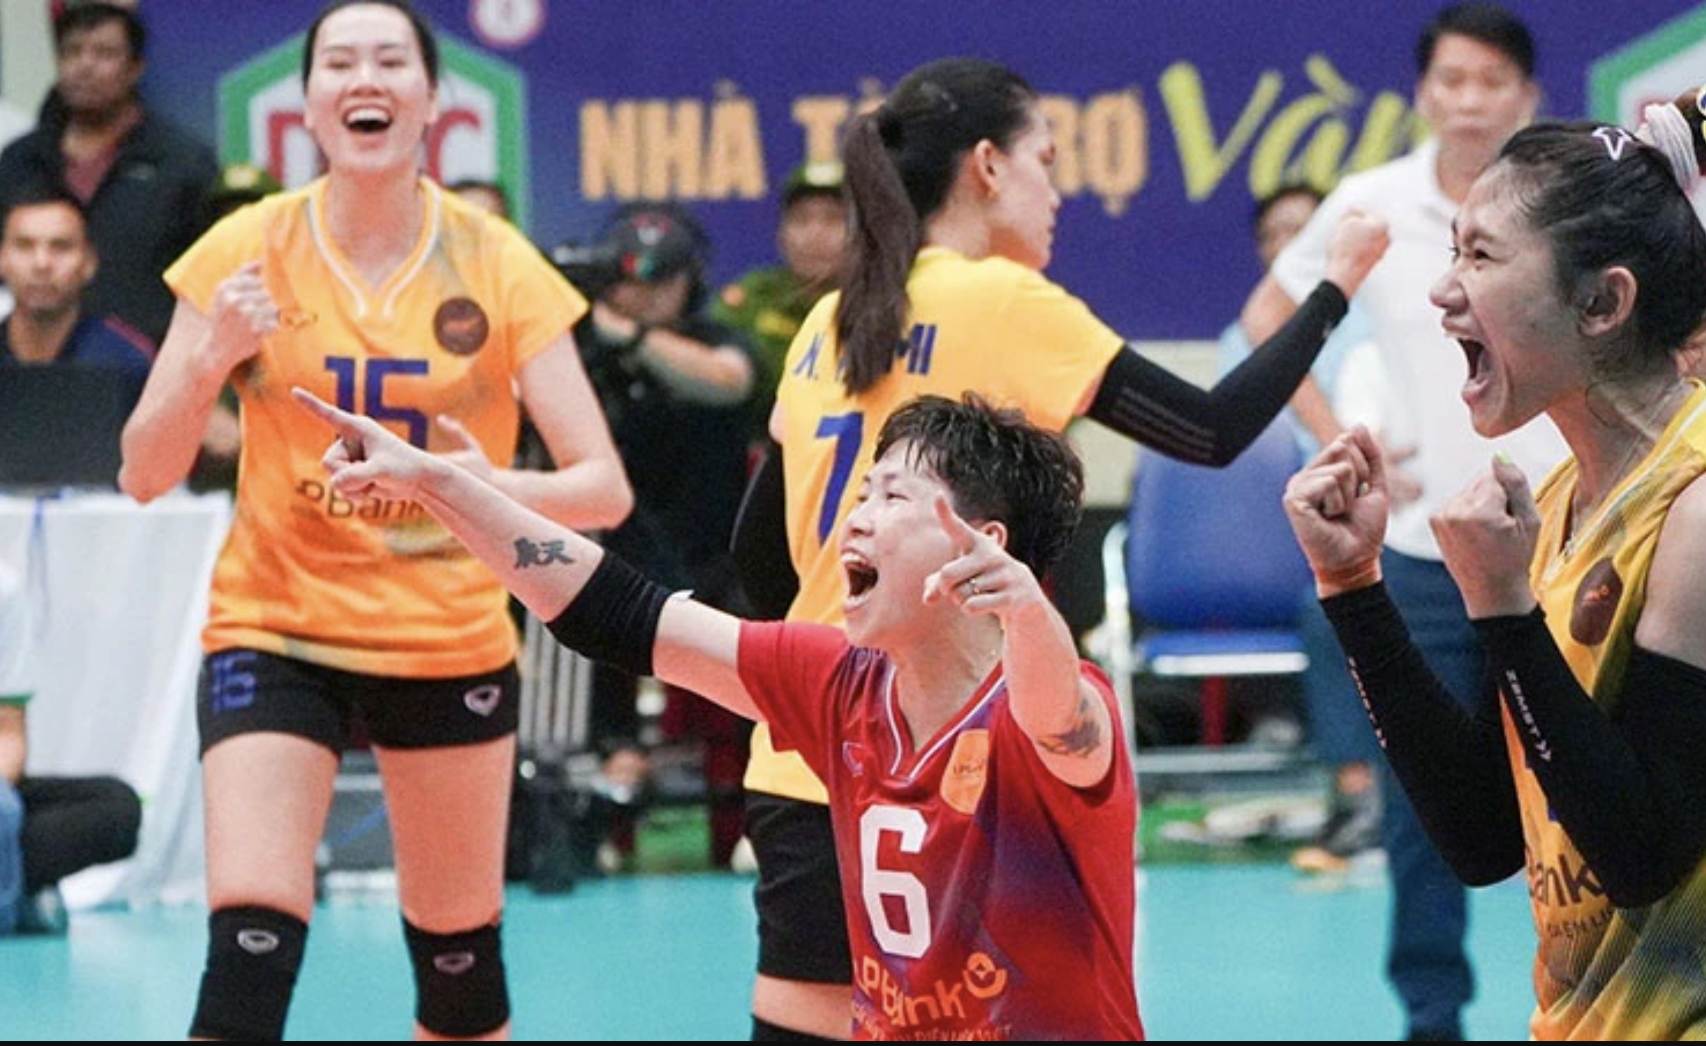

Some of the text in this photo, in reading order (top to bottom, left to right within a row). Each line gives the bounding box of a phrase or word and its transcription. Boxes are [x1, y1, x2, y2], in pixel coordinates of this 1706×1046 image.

[581, 78, 768, 201] NHÀ
[1036, 86, 1149, 216] RỢ
[1159, 54, 1432, 202] Vàn
[325, 355, 429, 452] 15
[815, 411, 864, 549] 7
[860, 804, 932, 960] 6
